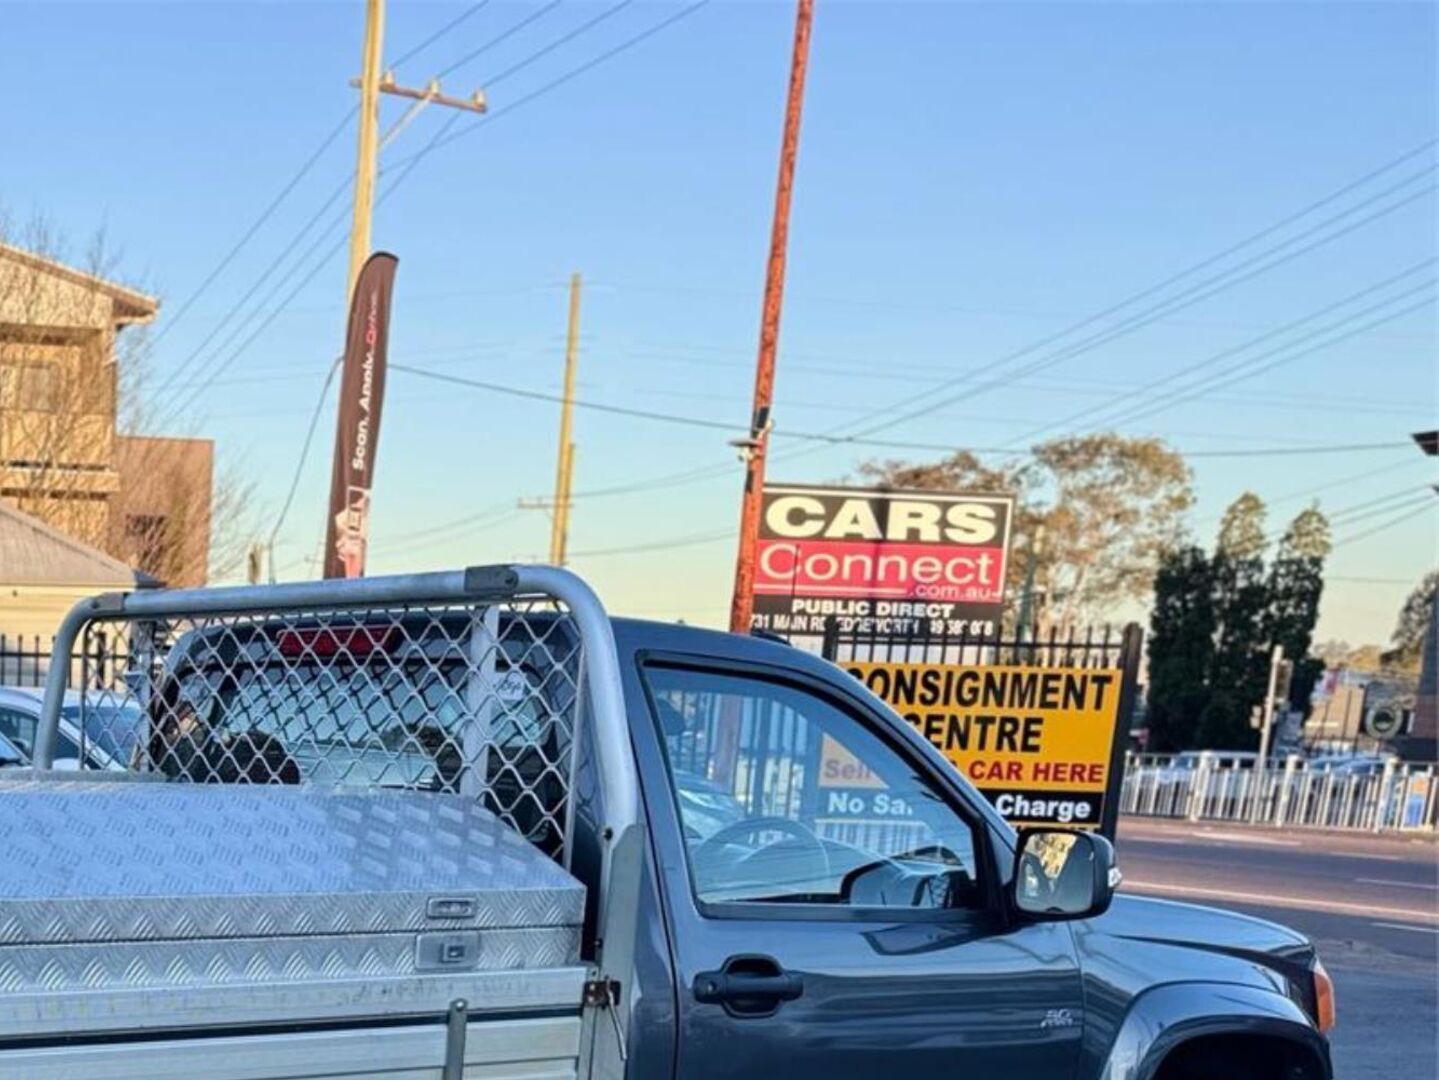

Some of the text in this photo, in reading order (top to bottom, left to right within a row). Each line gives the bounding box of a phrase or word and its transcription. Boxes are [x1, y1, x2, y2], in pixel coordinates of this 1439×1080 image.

[352, 416, 370, 471] Scan.
[766, 496, 997, 545] CARS
[760, 542, 994, 585] Connect
[792, 599, 955, 619] PUBLIC DIRECT
[773, 615, 808, 631] MAIN
[968, 761, 1022, 781] CAR
[1033, 763, 1105, 783] HERE
[827, 792, 864, 815] No
[995, 795, 1091, 819] Charge
